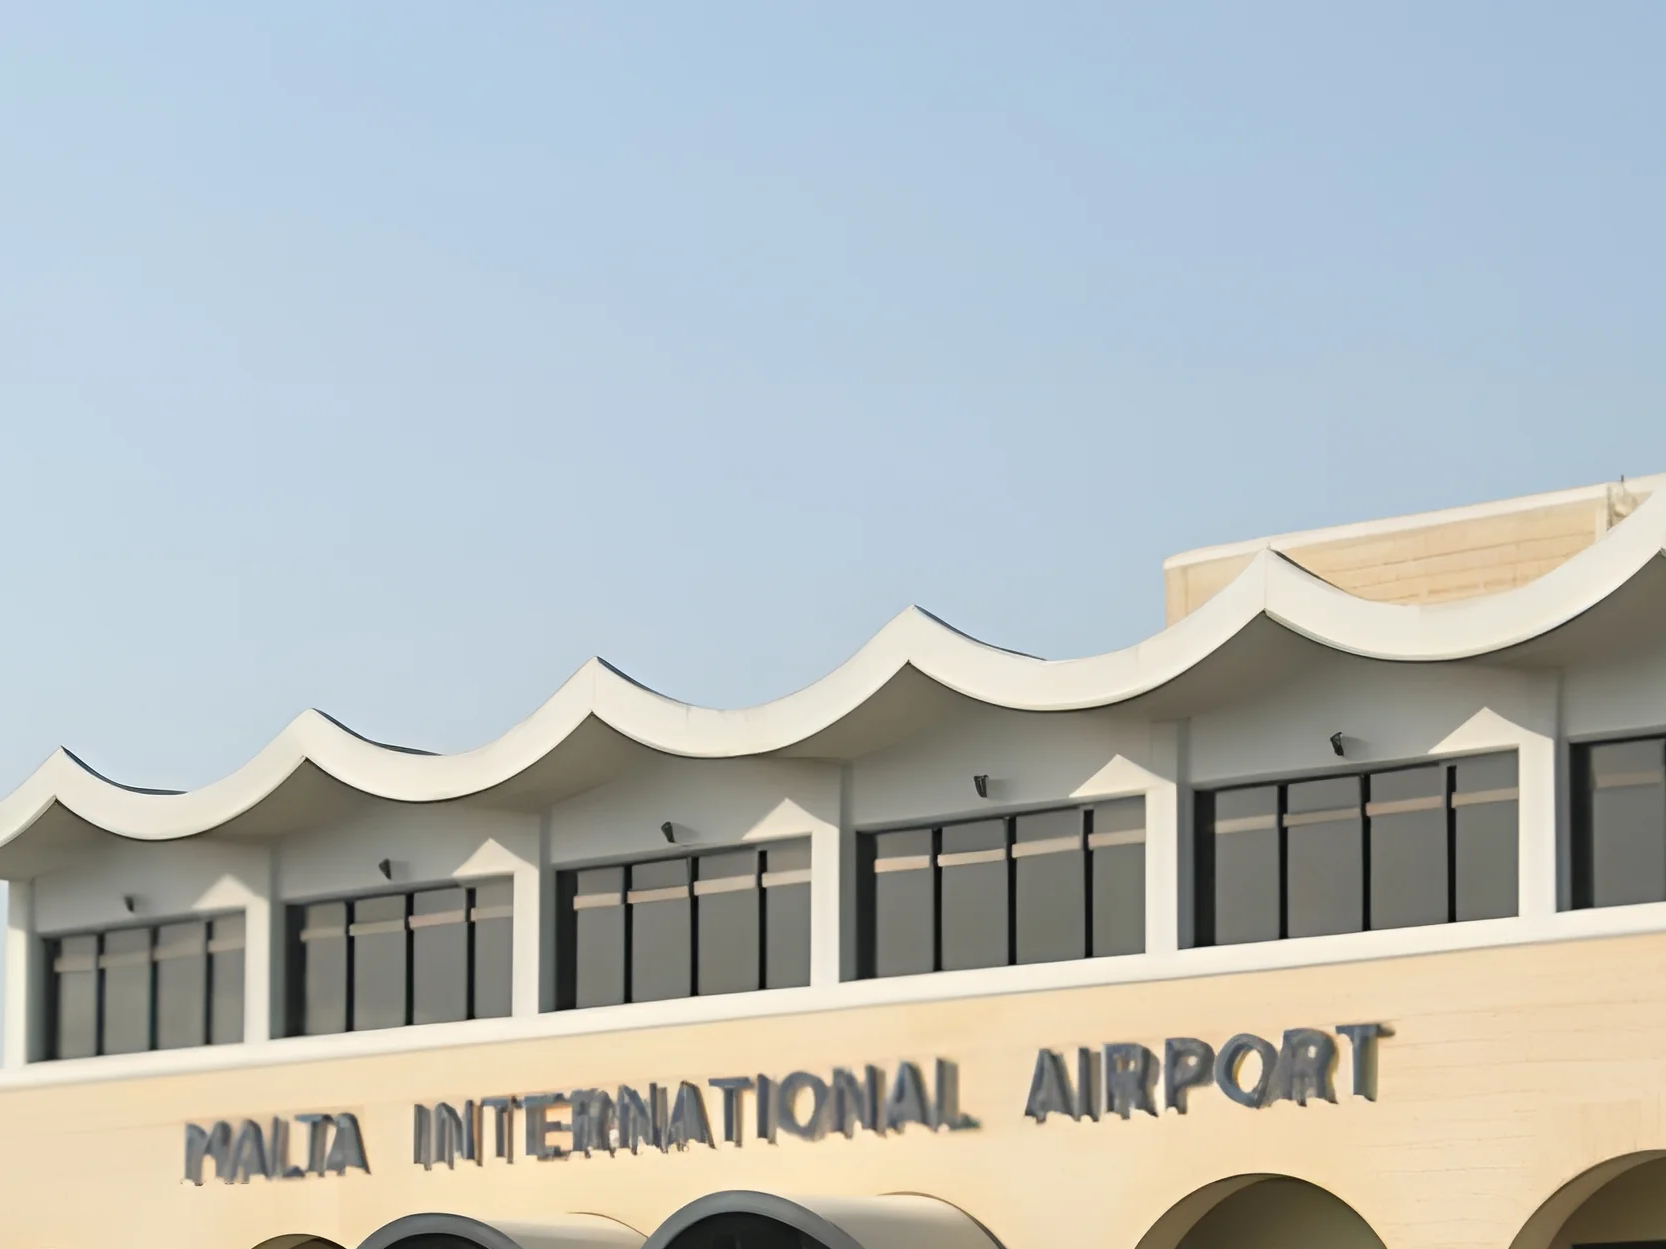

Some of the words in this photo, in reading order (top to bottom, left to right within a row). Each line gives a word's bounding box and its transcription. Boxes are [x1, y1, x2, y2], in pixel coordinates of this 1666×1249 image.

[183, 1112, 371, 1186] MALTA
[413, 1057, 982, 1171] INTERNATIONAL
[1024, 1022, 1396, 1124] AIRPORT
